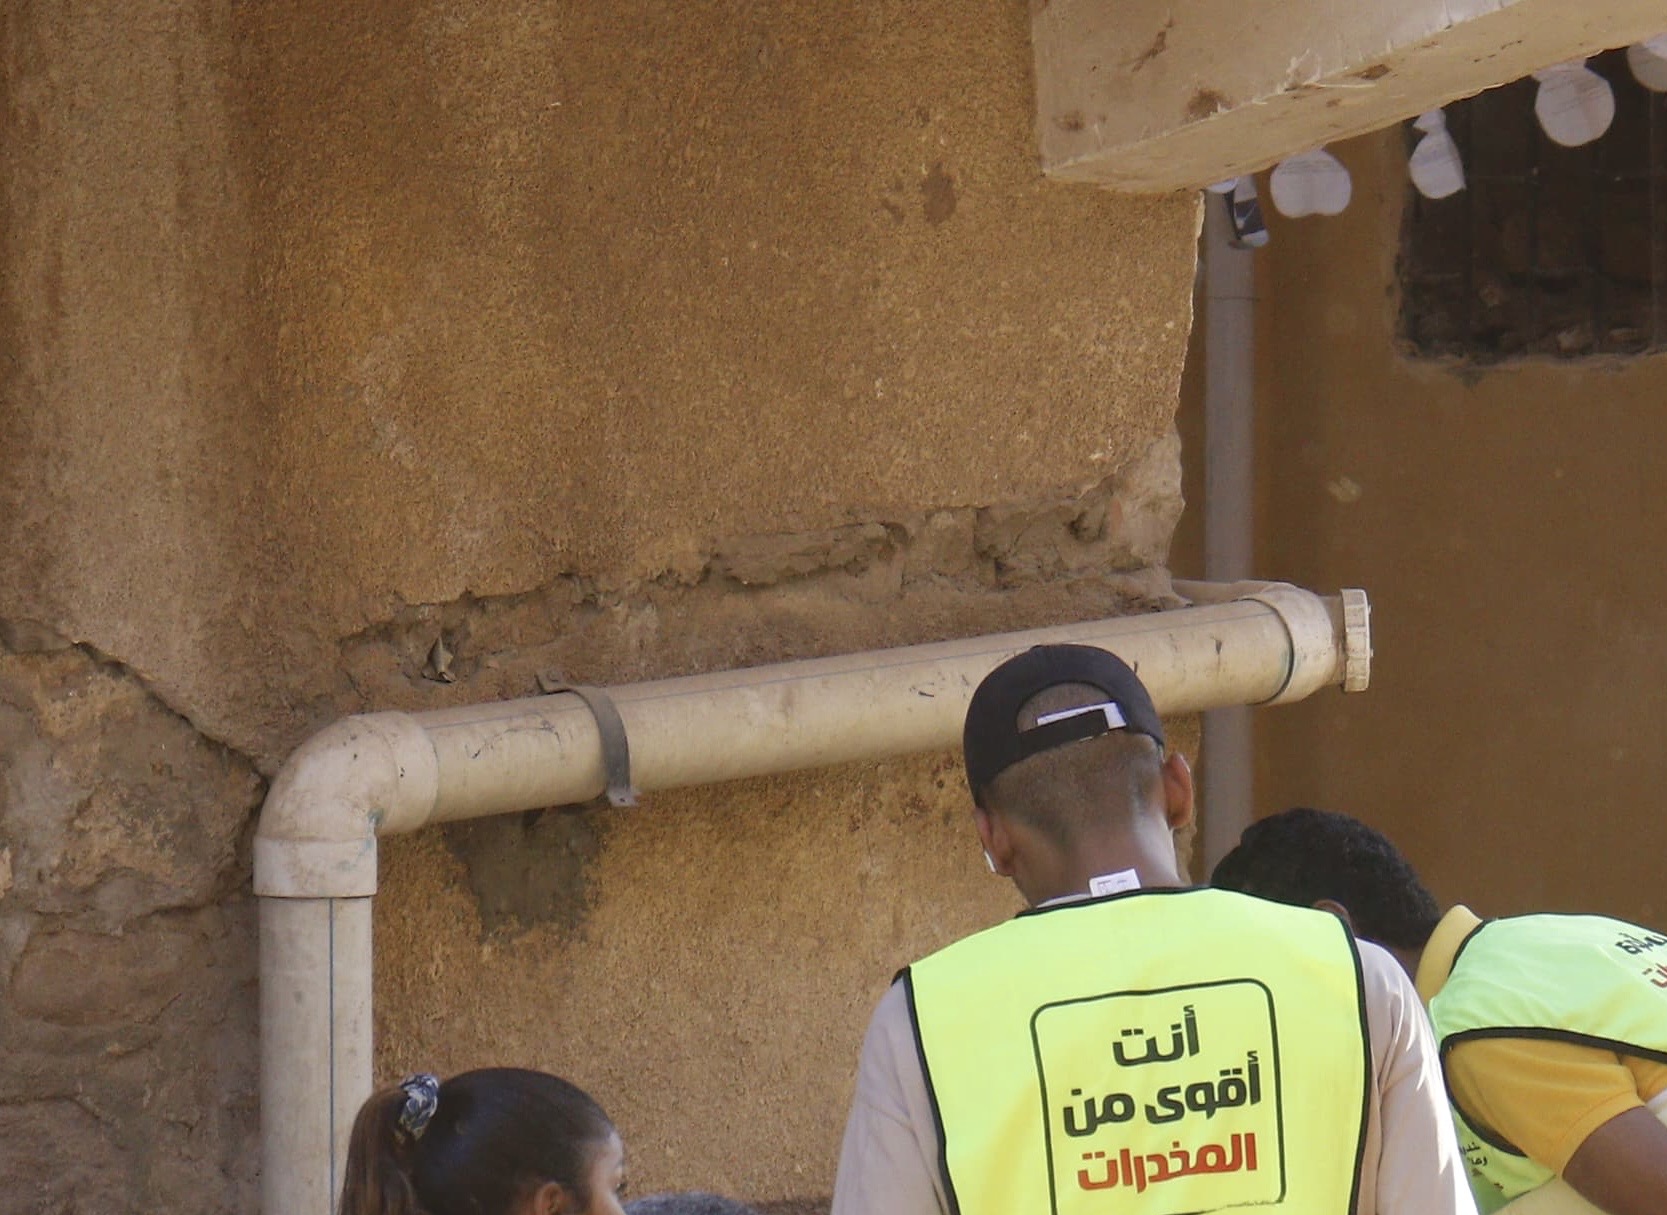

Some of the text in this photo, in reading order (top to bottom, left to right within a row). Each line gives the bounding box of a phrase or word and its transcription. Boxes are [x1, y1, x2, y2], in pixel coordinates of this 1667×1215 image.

[1112, 1004, 1200, 1067] أنت
[1062, 1050, 1261, 1138] أقوى من
[1077, 1132, 1258, 1194] المخدرات
